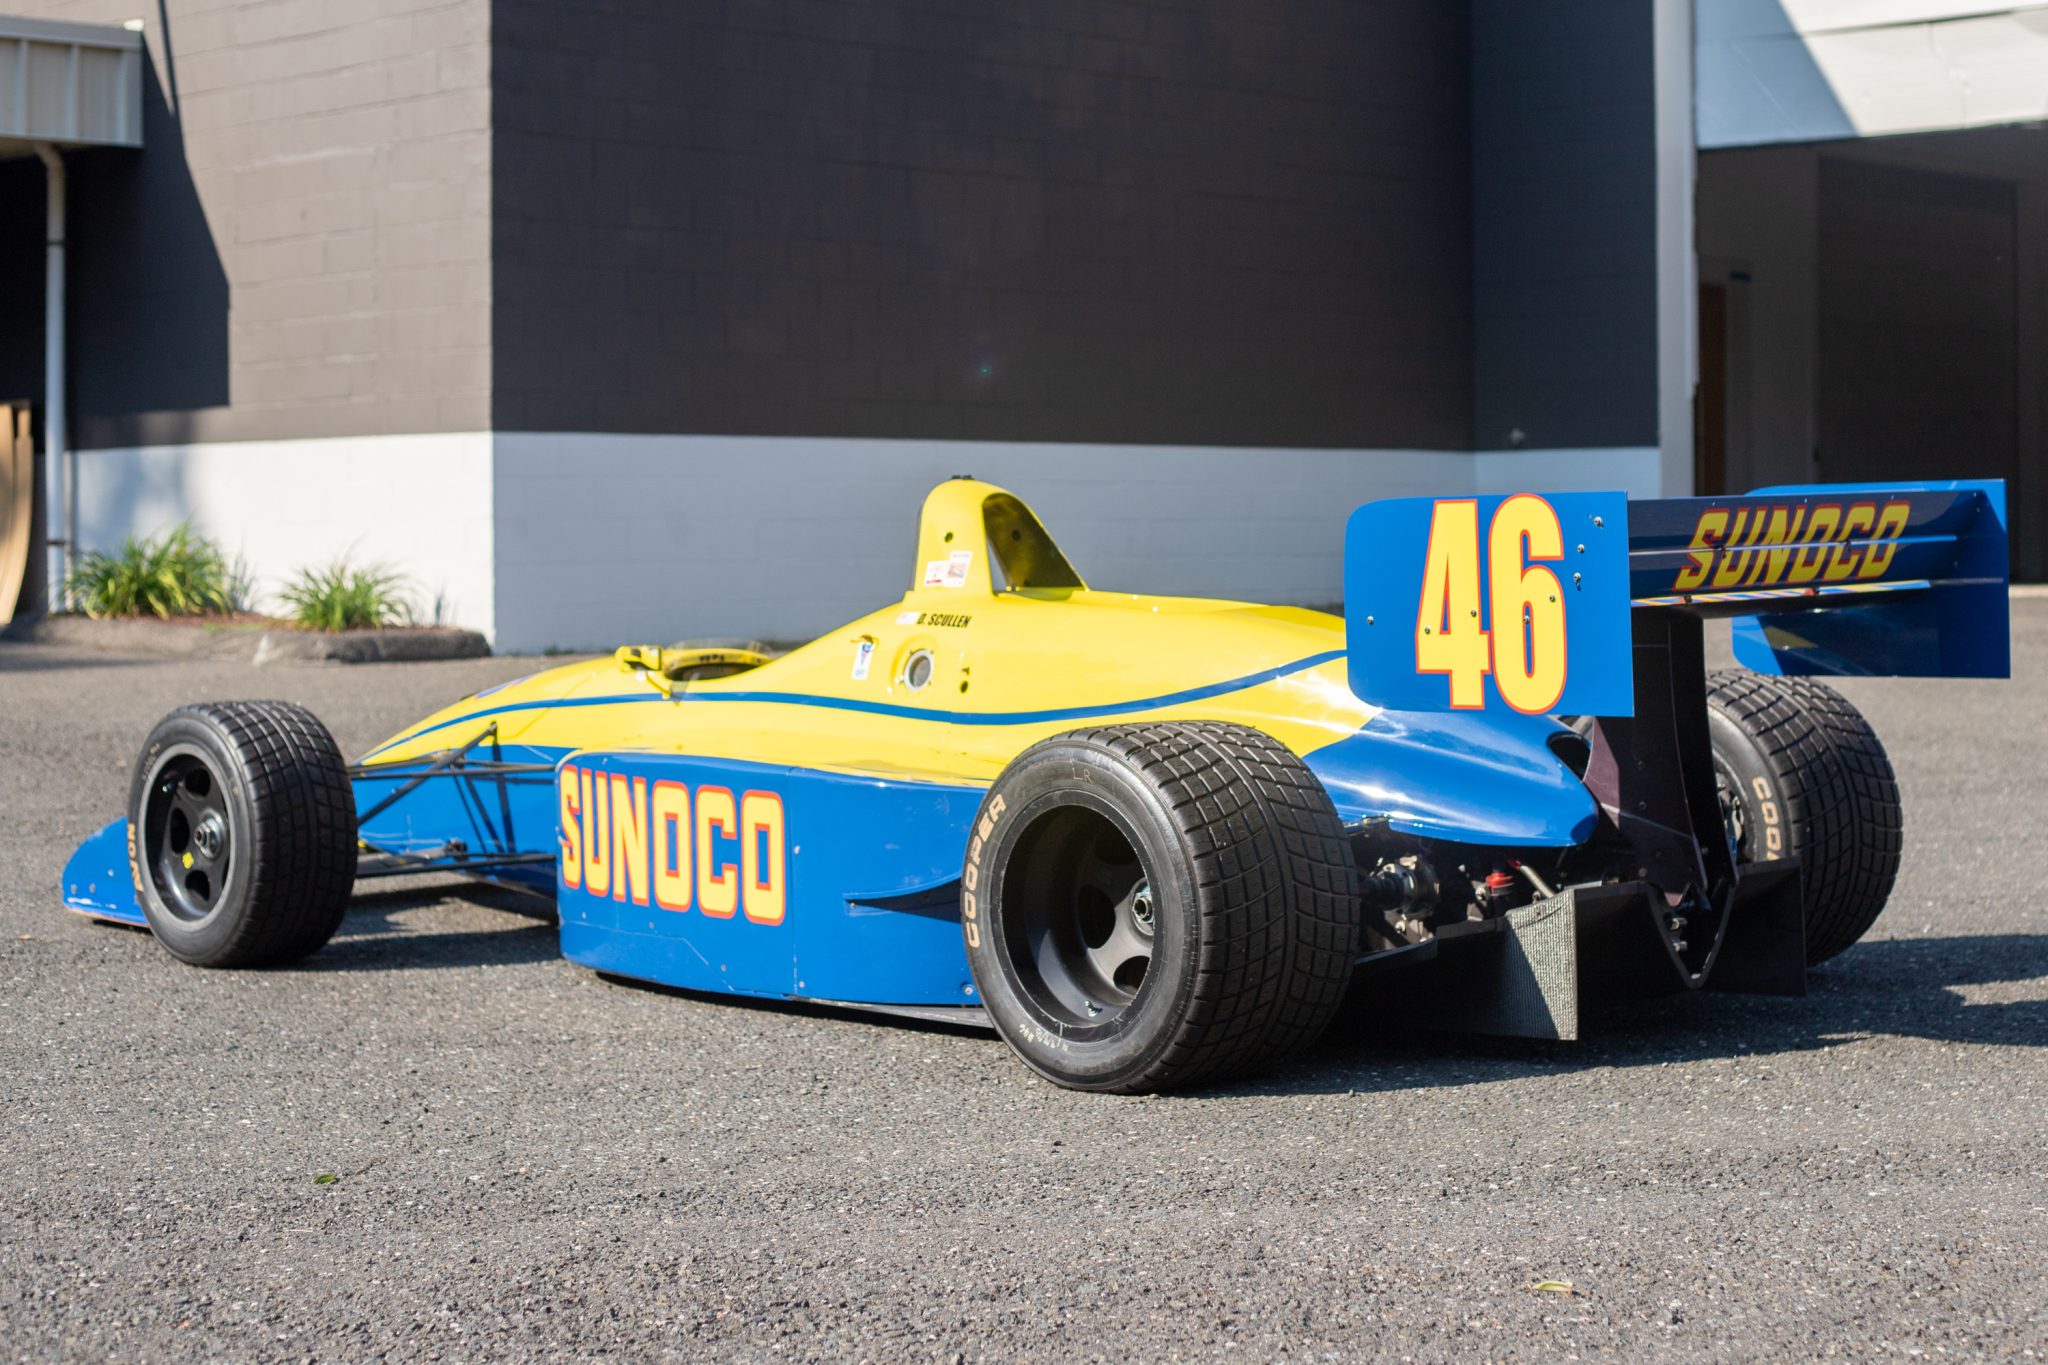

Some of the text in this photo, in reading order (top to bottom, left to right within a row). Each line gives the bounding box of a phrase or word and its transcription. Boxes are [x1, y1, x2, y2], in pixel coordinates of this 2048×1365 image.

[928, 613, 972, 628] SCULLEN
[1415, 493, 1568, 715] 46
[1672, 500, 1911, 592] SUNOCO
[559, 763, 786, 927] SUNOCO
[965, 794, 1007, 948] COOPER
